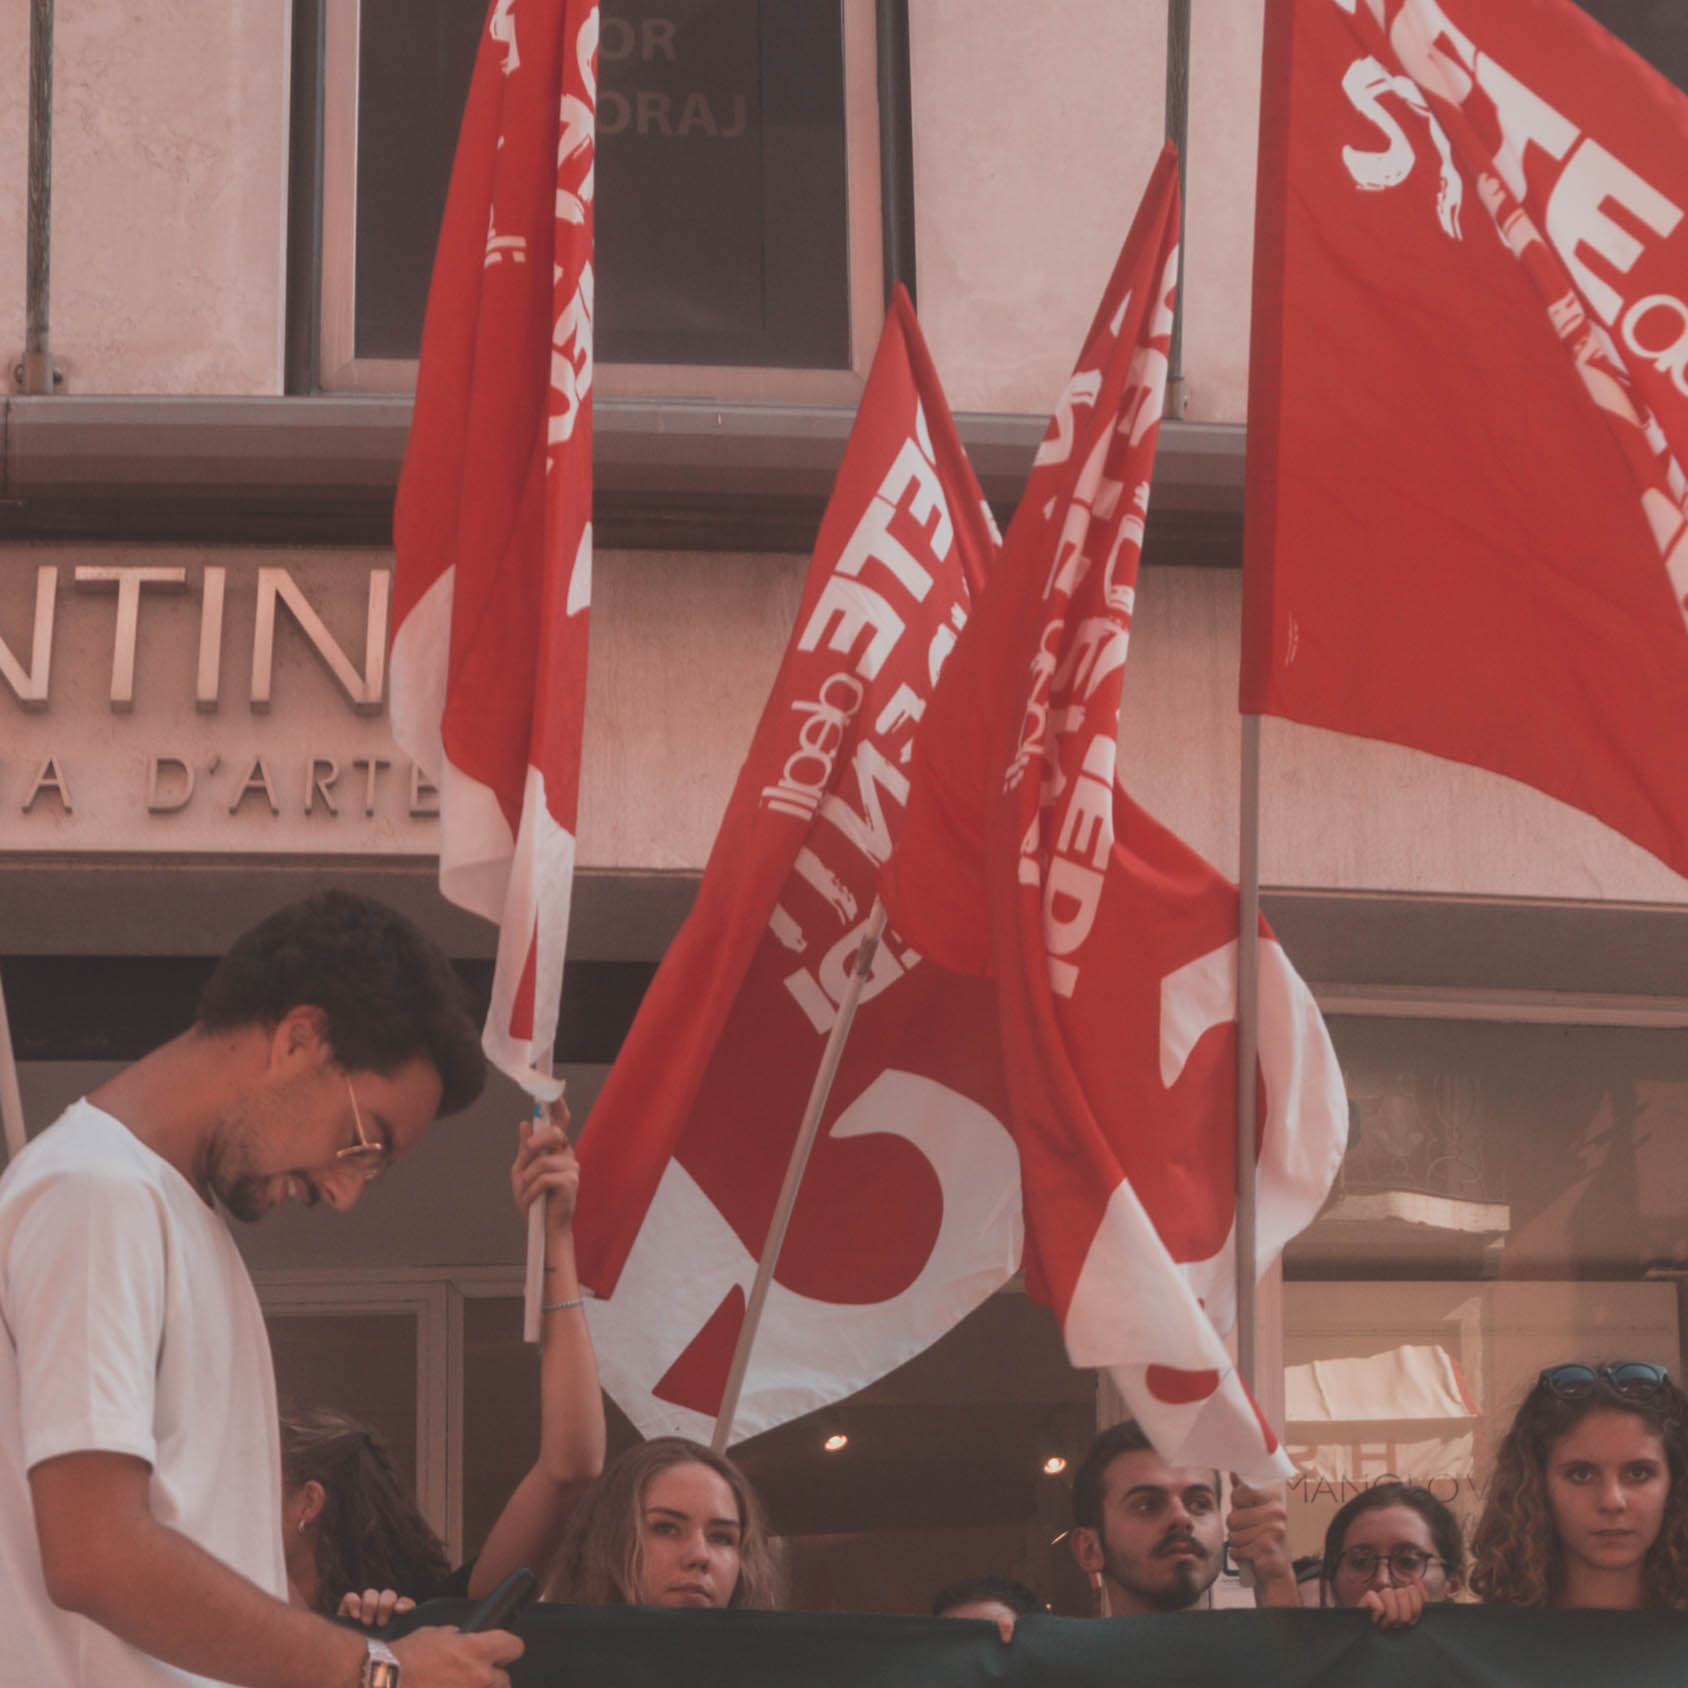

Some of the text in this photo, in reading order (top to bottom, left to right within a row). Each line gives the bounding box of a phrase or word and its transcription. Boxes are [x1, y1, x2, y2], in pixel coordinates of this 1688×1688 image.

[596, 16, 678, 62] OR
[595, 91, 748, 138] ORAJ
[1390, 0, 1685, 327] ETE
[148, 754, 441, 817] D'ARTE
[1286, 1472, 1460, 1505] MANO
